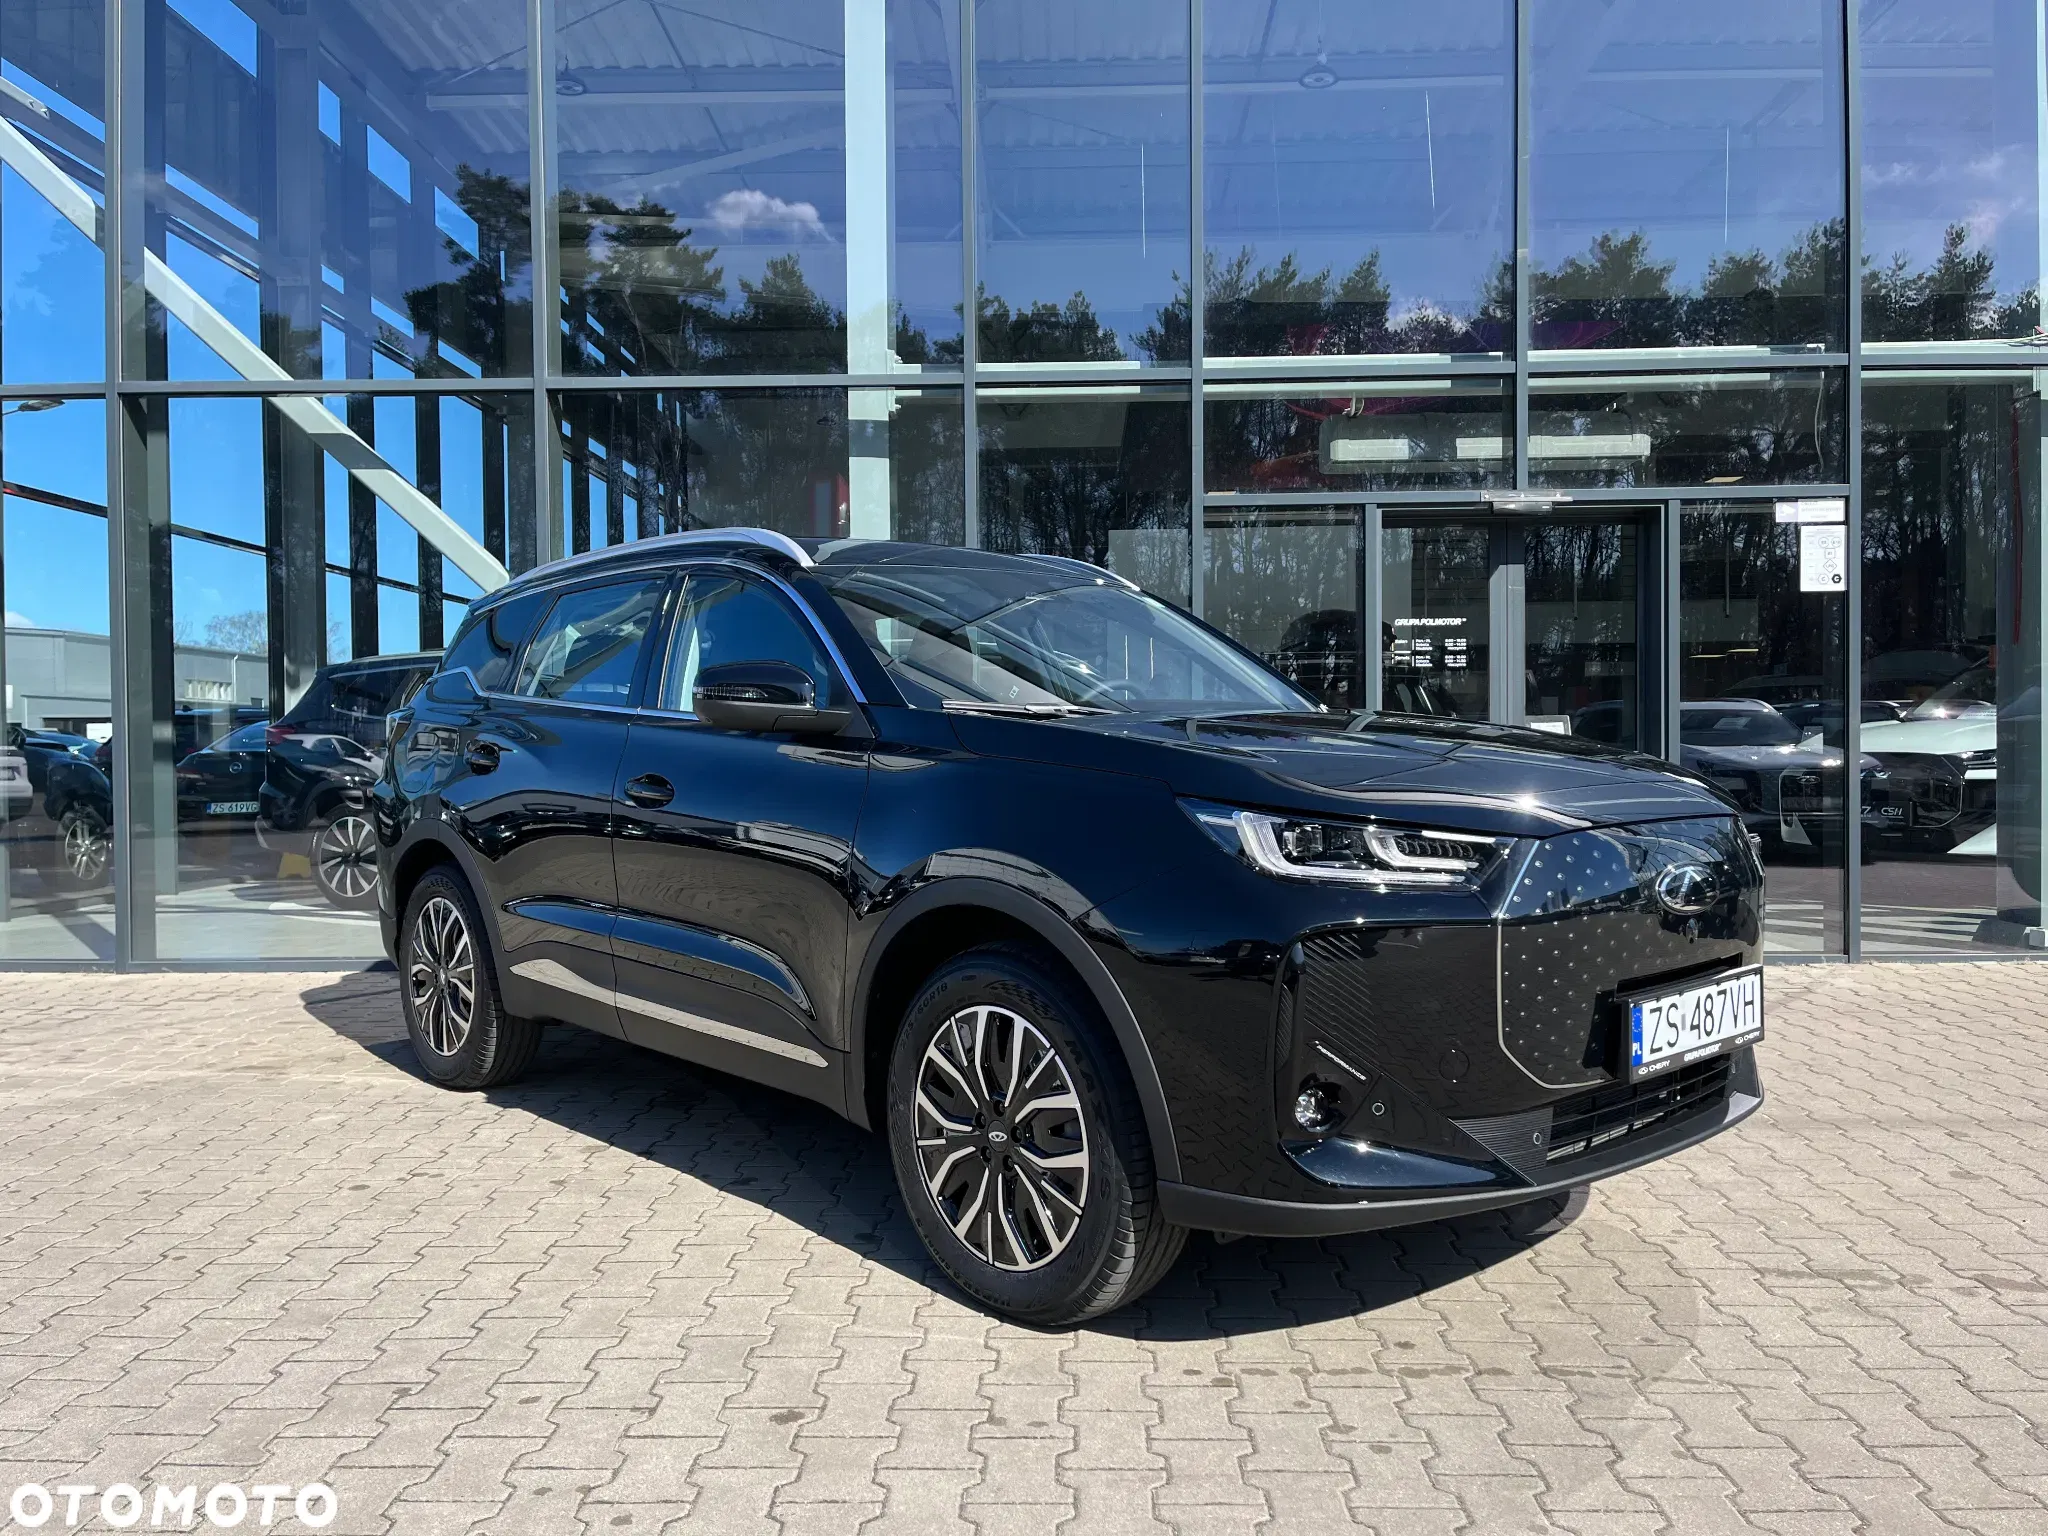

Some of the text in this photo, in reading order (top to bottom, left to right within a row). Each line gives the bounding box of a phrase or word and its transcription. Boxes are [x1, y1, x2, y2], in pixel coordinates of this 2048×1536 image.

[213, 802, 258, 813] ZS 619VG
[1649, 980, 1756, 1055] ZS 487VH
[1316, 1044, 1367, 1080] PERFORMANCE
[1632, 1042, 1642, 1056] PL
[1649, 1060, 1671, 1073] CHERY
[1744, 1031, 1761, 1041] CHERY
